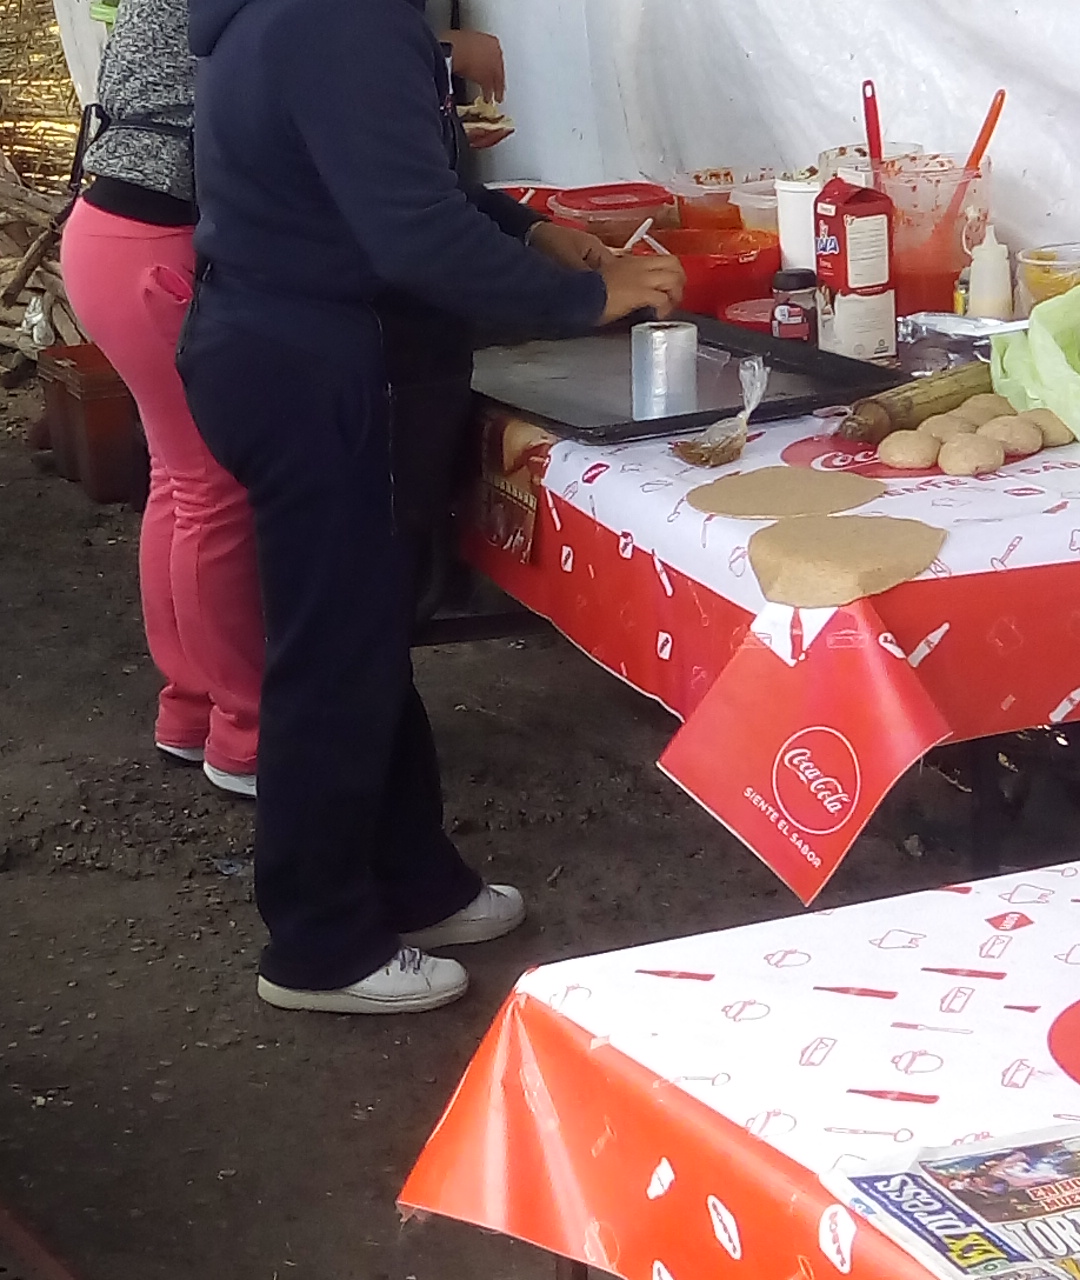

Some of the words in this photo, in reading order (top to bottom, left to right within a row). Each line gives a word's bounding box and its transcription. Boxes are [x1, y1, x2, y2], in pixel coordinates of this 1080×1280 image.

[742, 786, 780, 823] SIENTE
[776, 820, 791, 837] EL
[788, 832, 824, 869] SABOR
